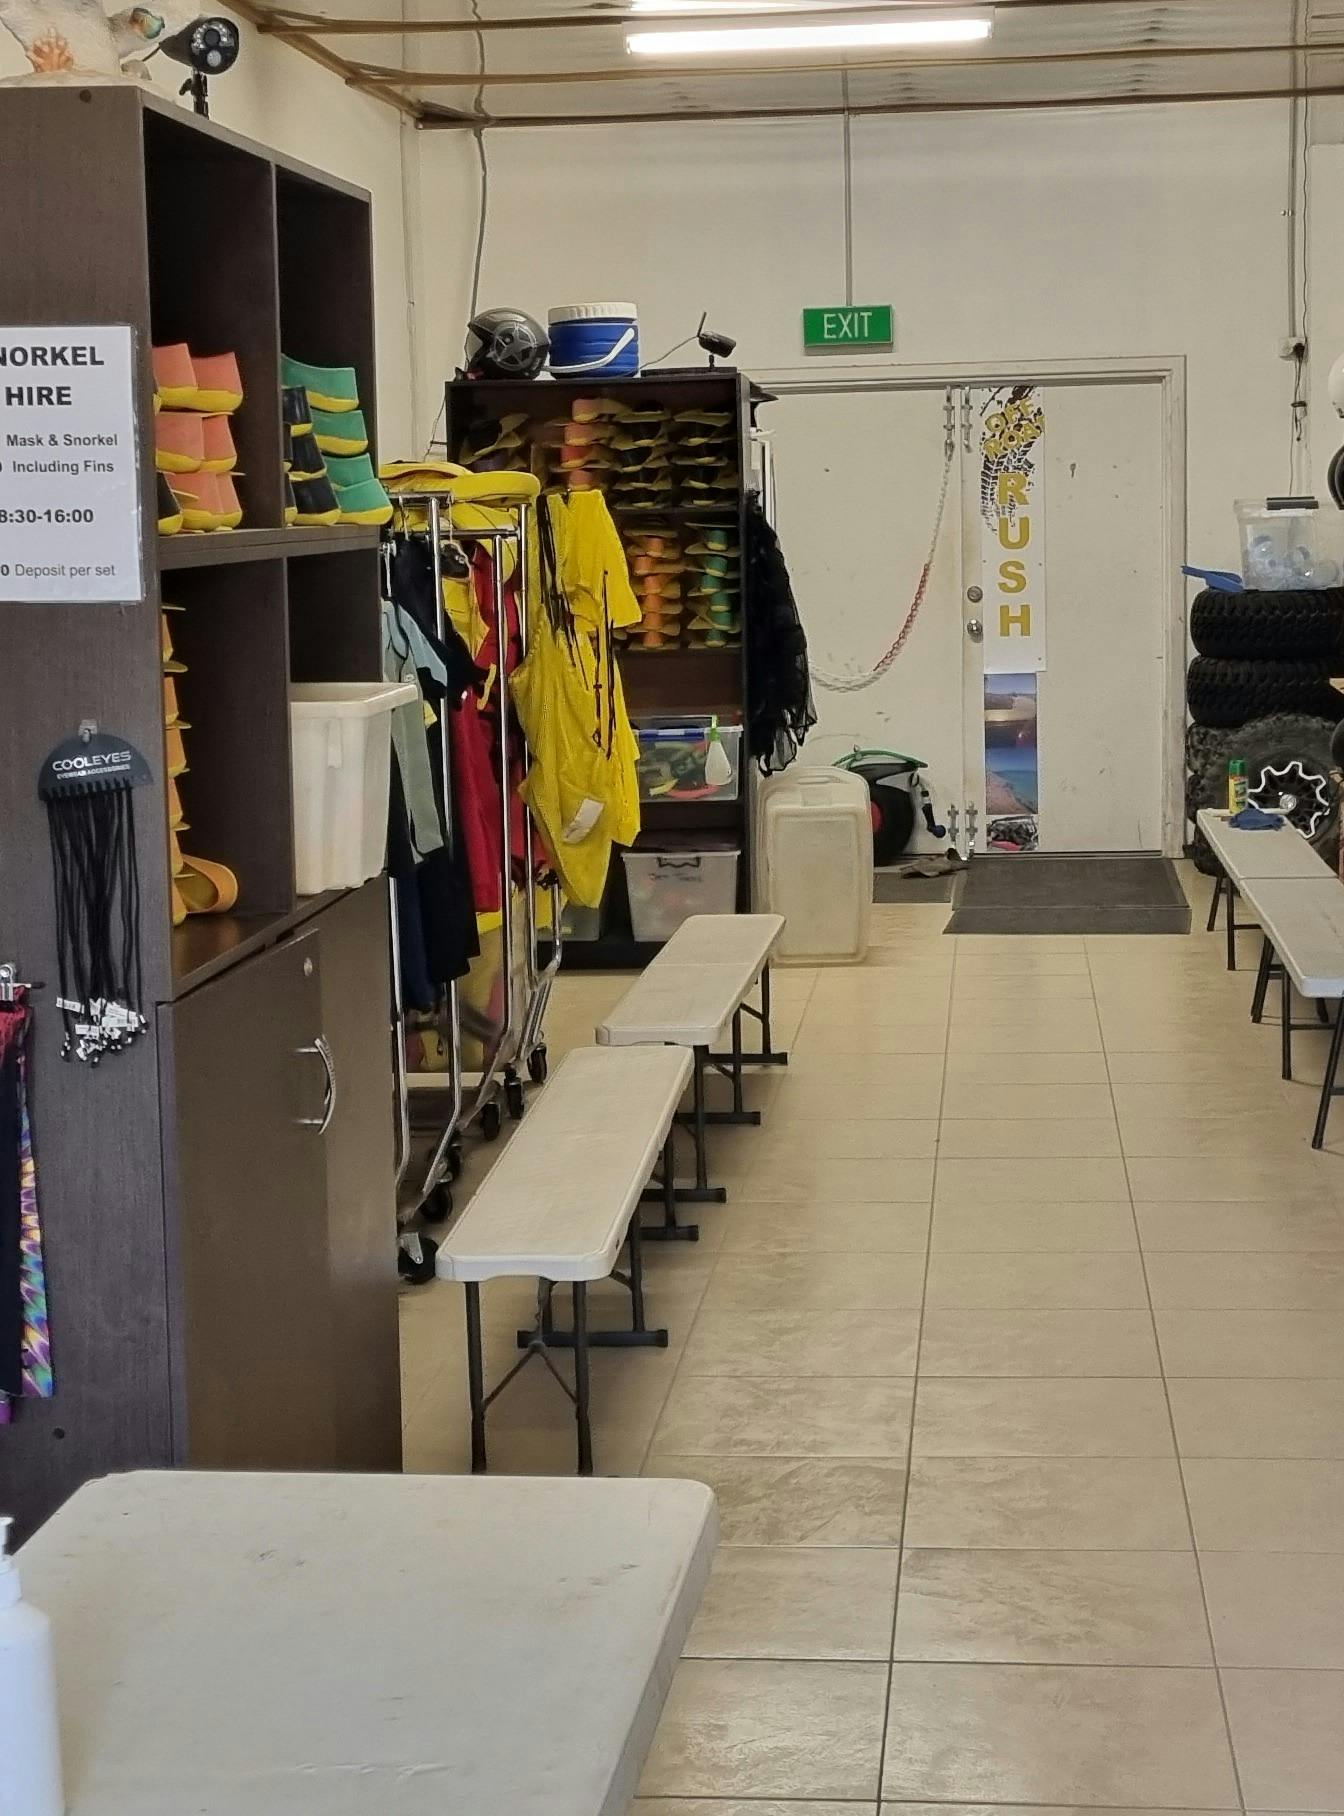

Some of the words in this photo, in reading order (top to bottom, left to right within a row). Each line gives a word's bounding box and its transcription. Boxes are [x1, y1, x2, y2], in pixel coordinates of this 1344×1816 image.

[824, 312, 872, 339] EXIT
[5, 386, 72, 406] HIRE
[6, 434, 44, 447] Mask
[48, 434, 59, 447] &
[63, 433, 118, 446] Snorkel
[13, 460, 79, 475] Including
[84, 460, 114, 473] Fins
[997, 472, 1031, 637] RUSH
[15, 563, 66, 578] Deposit
[70, 566, 91, 578] per
[95, 564, 116, 576] set
[52, 750, 132, 771] COOLEYES
